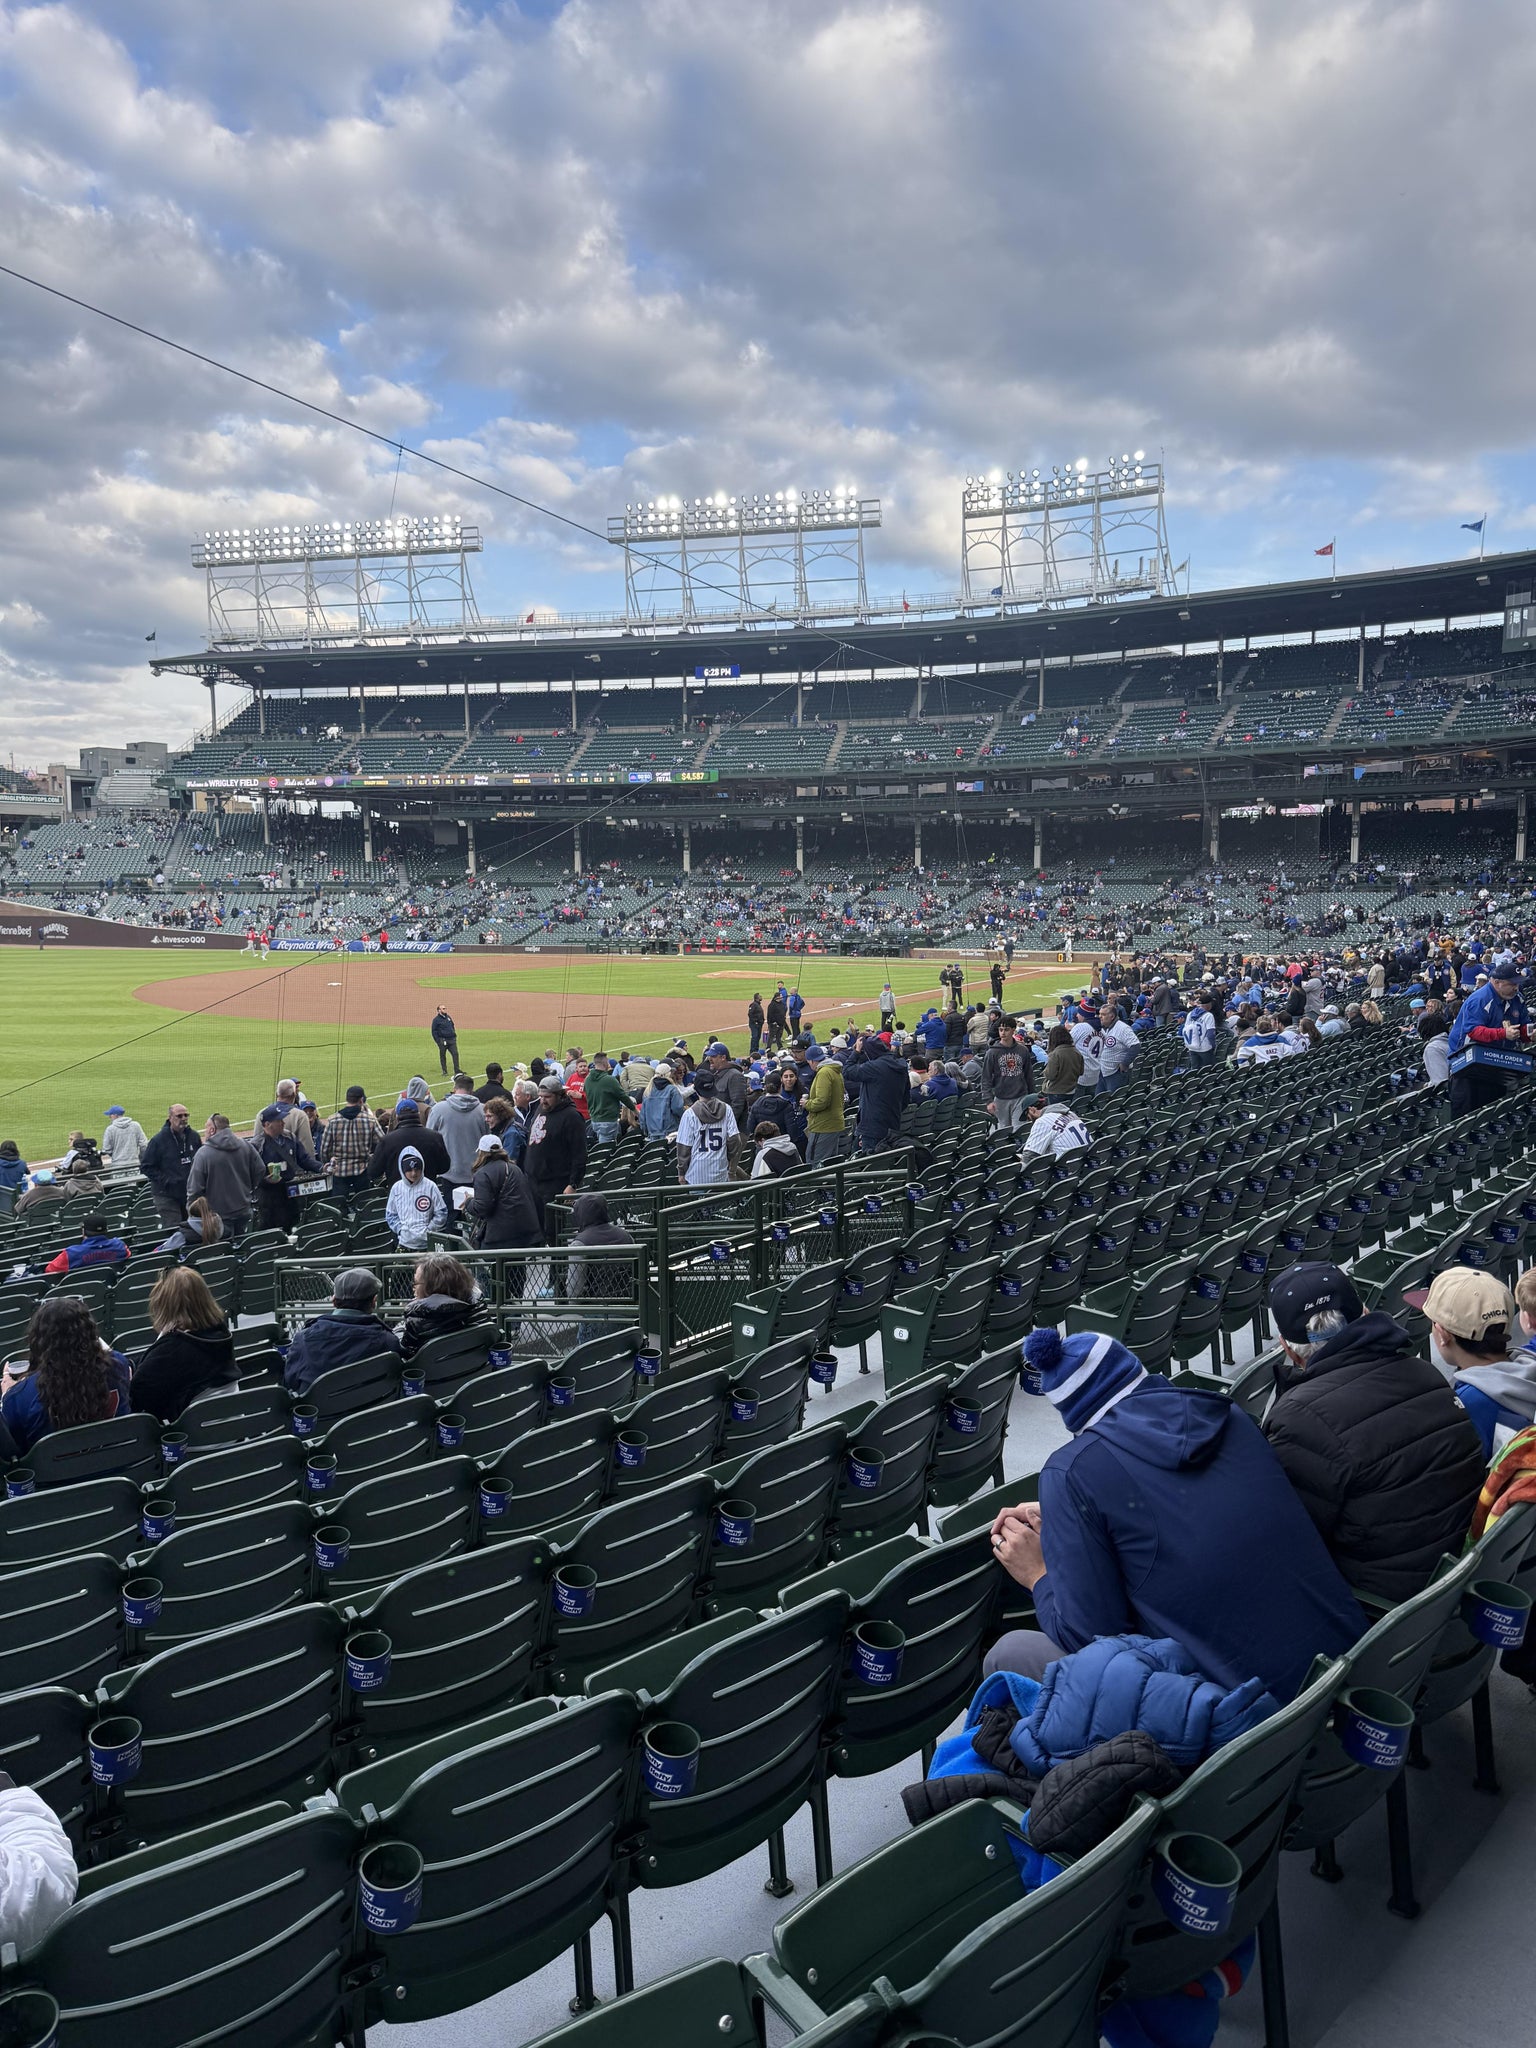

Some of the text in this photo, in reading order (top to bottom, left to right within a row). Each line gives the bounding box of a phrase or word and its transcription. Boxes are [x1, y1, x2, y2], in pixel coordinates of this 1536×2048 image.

[704, 668, 720, 676] 6:28
[208, 779, 239, 787] WRIGLEY
[240, 779, 259, 787] FIELD
[17, 925, 32, 937] Beef
[44, 923, 69, 935] MARQUEE
[190, 936, 206, 944] QQQ
[277, 940, 316, 951] Reynolds
[368, 941, 429, 952] Reyolds Wrap
[1091, 1040, 1100, 1058] 4
[1483, 1051, 1504, 1059] MOBILE
[699, 1128, 723, 1152] 15
[898, 1330, 904, 1338] 6
[1484, 1608, 1512, 1624] Hefty
[862, 1660, 884, 1671] Hefty
[869, 1672, 892, 1681] Hefty
[1357, 1721, 1388, 1740] Hefty
[1365, 1739, 1397, 1754] Hefty
[650, 1767, 672, 1781] Hefty
[656, 1782, 682, 1792] Hefty
[1165, 1870, 1195, 1898] Hefty
[1173, 1893, 1208, 1916] Hefty
[369, 1915, 398, 1928] Hefty
[1183, 1914, 1218, 1930] Hefty
